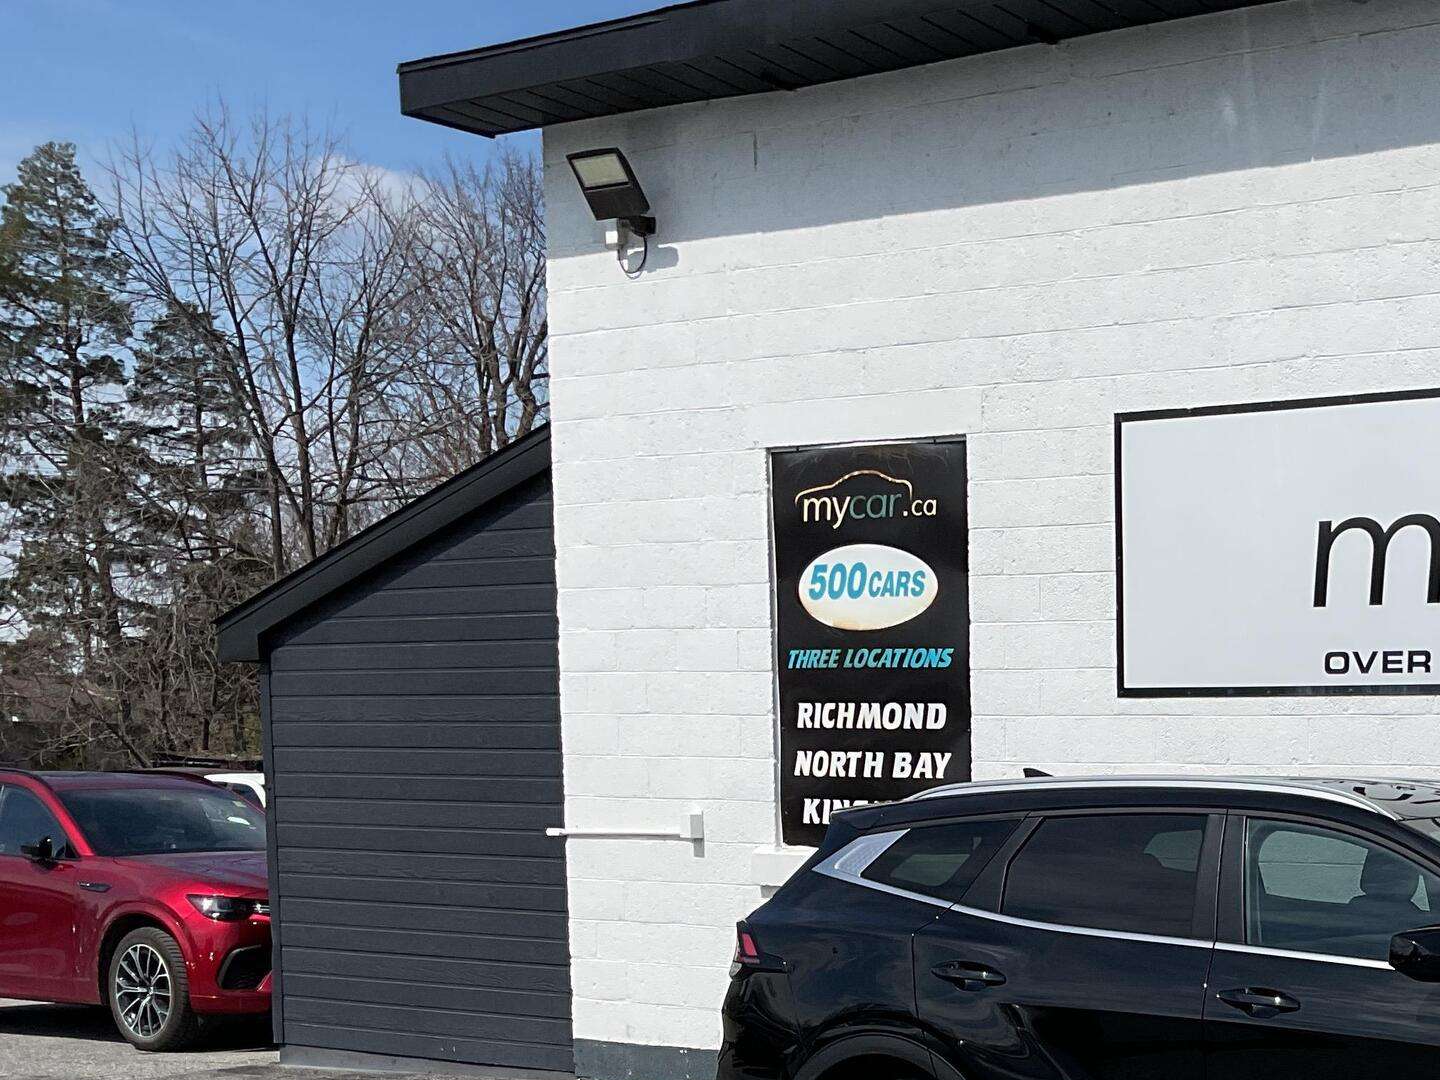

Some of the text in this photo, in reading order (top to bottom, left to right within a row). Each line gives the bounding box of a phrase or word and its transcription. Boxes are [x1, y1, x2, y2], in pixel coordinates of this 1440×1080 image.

[803, 492, 937, 529] mycar.ca
[808, 561, 926, 601] 500 CARS
[787, 647, 955, 669] THREE LOCATIONS
[1324, 650, 1432, 675] OVER
[796, 702, 947, 730] RICHMOND
[793, 750, 952, 779] NORTH BAY
